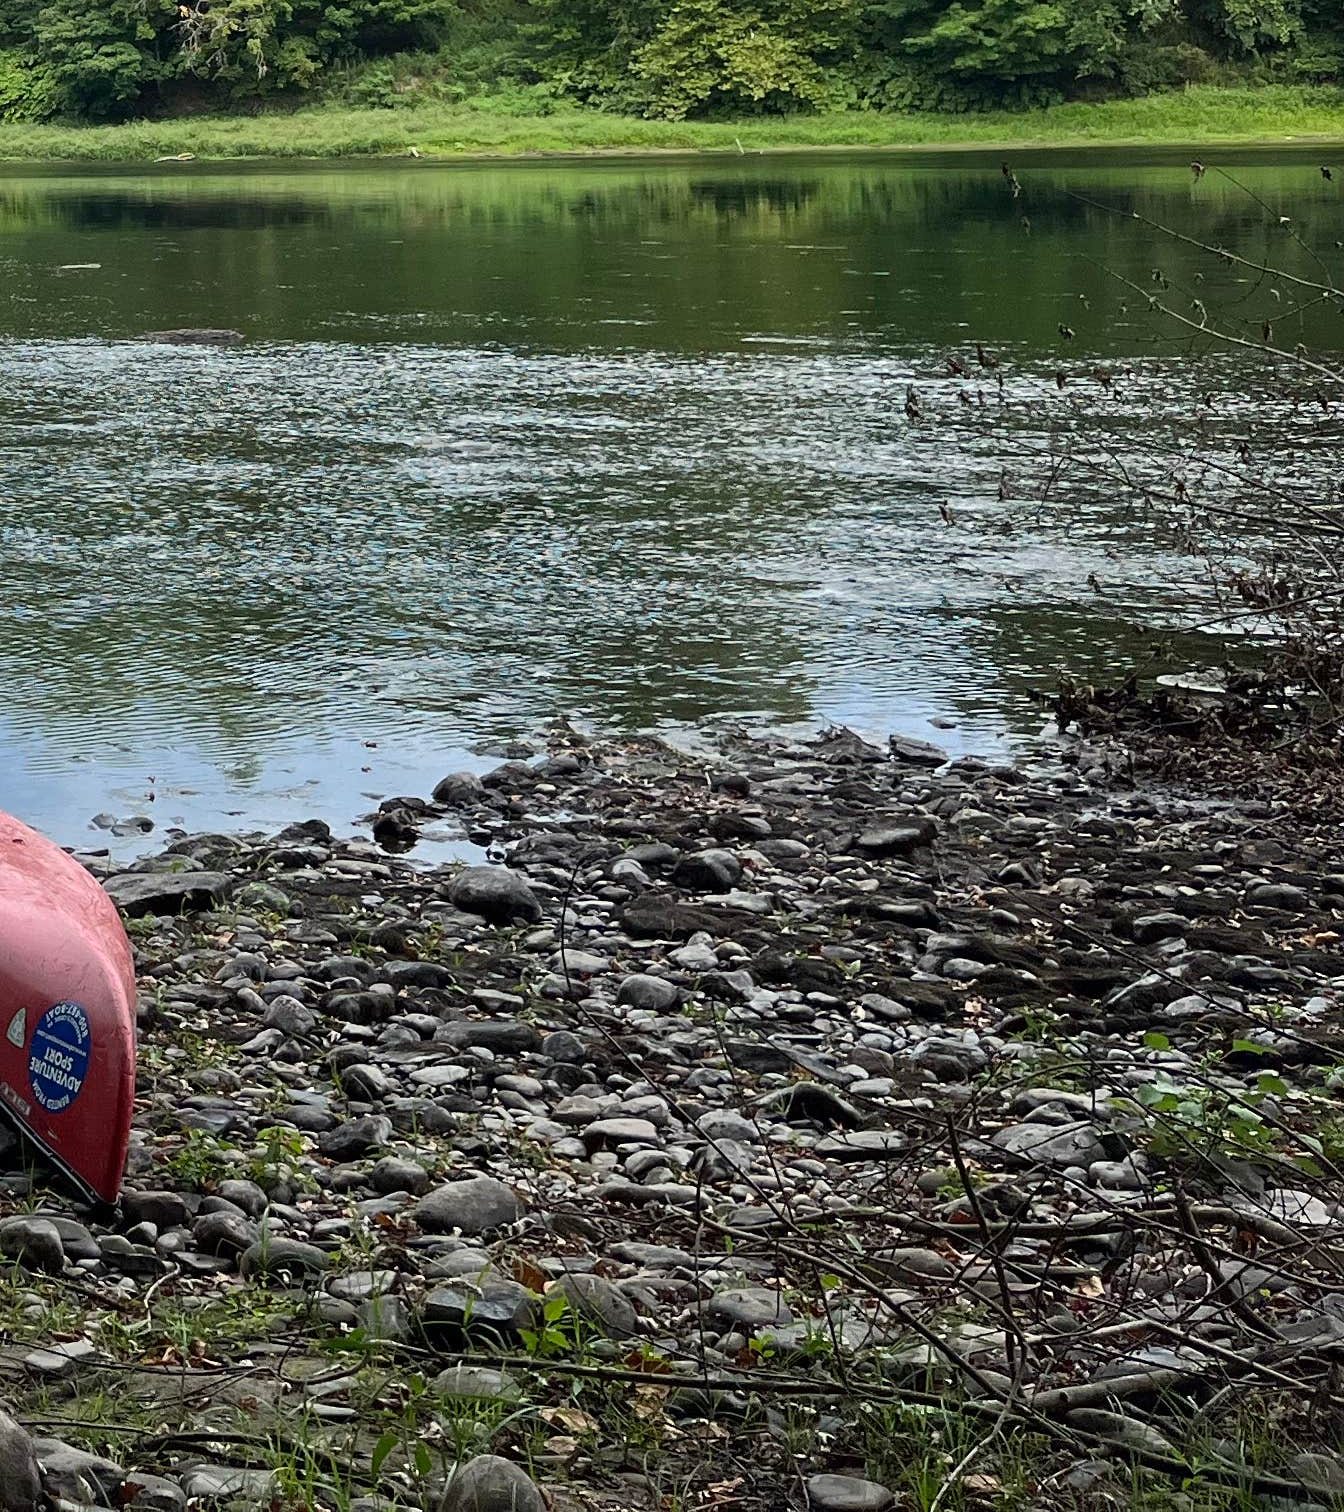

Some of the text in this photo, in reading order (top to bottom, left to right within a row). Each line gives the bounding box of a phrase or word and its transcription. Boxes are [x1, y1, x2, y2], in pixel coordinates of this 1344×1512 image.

[29, 1056, 82, 1093] ADVENTURE
[44, 1047, 74, 1072] SPORT
[32, 1079, 70, 1110] RENTED FROM
